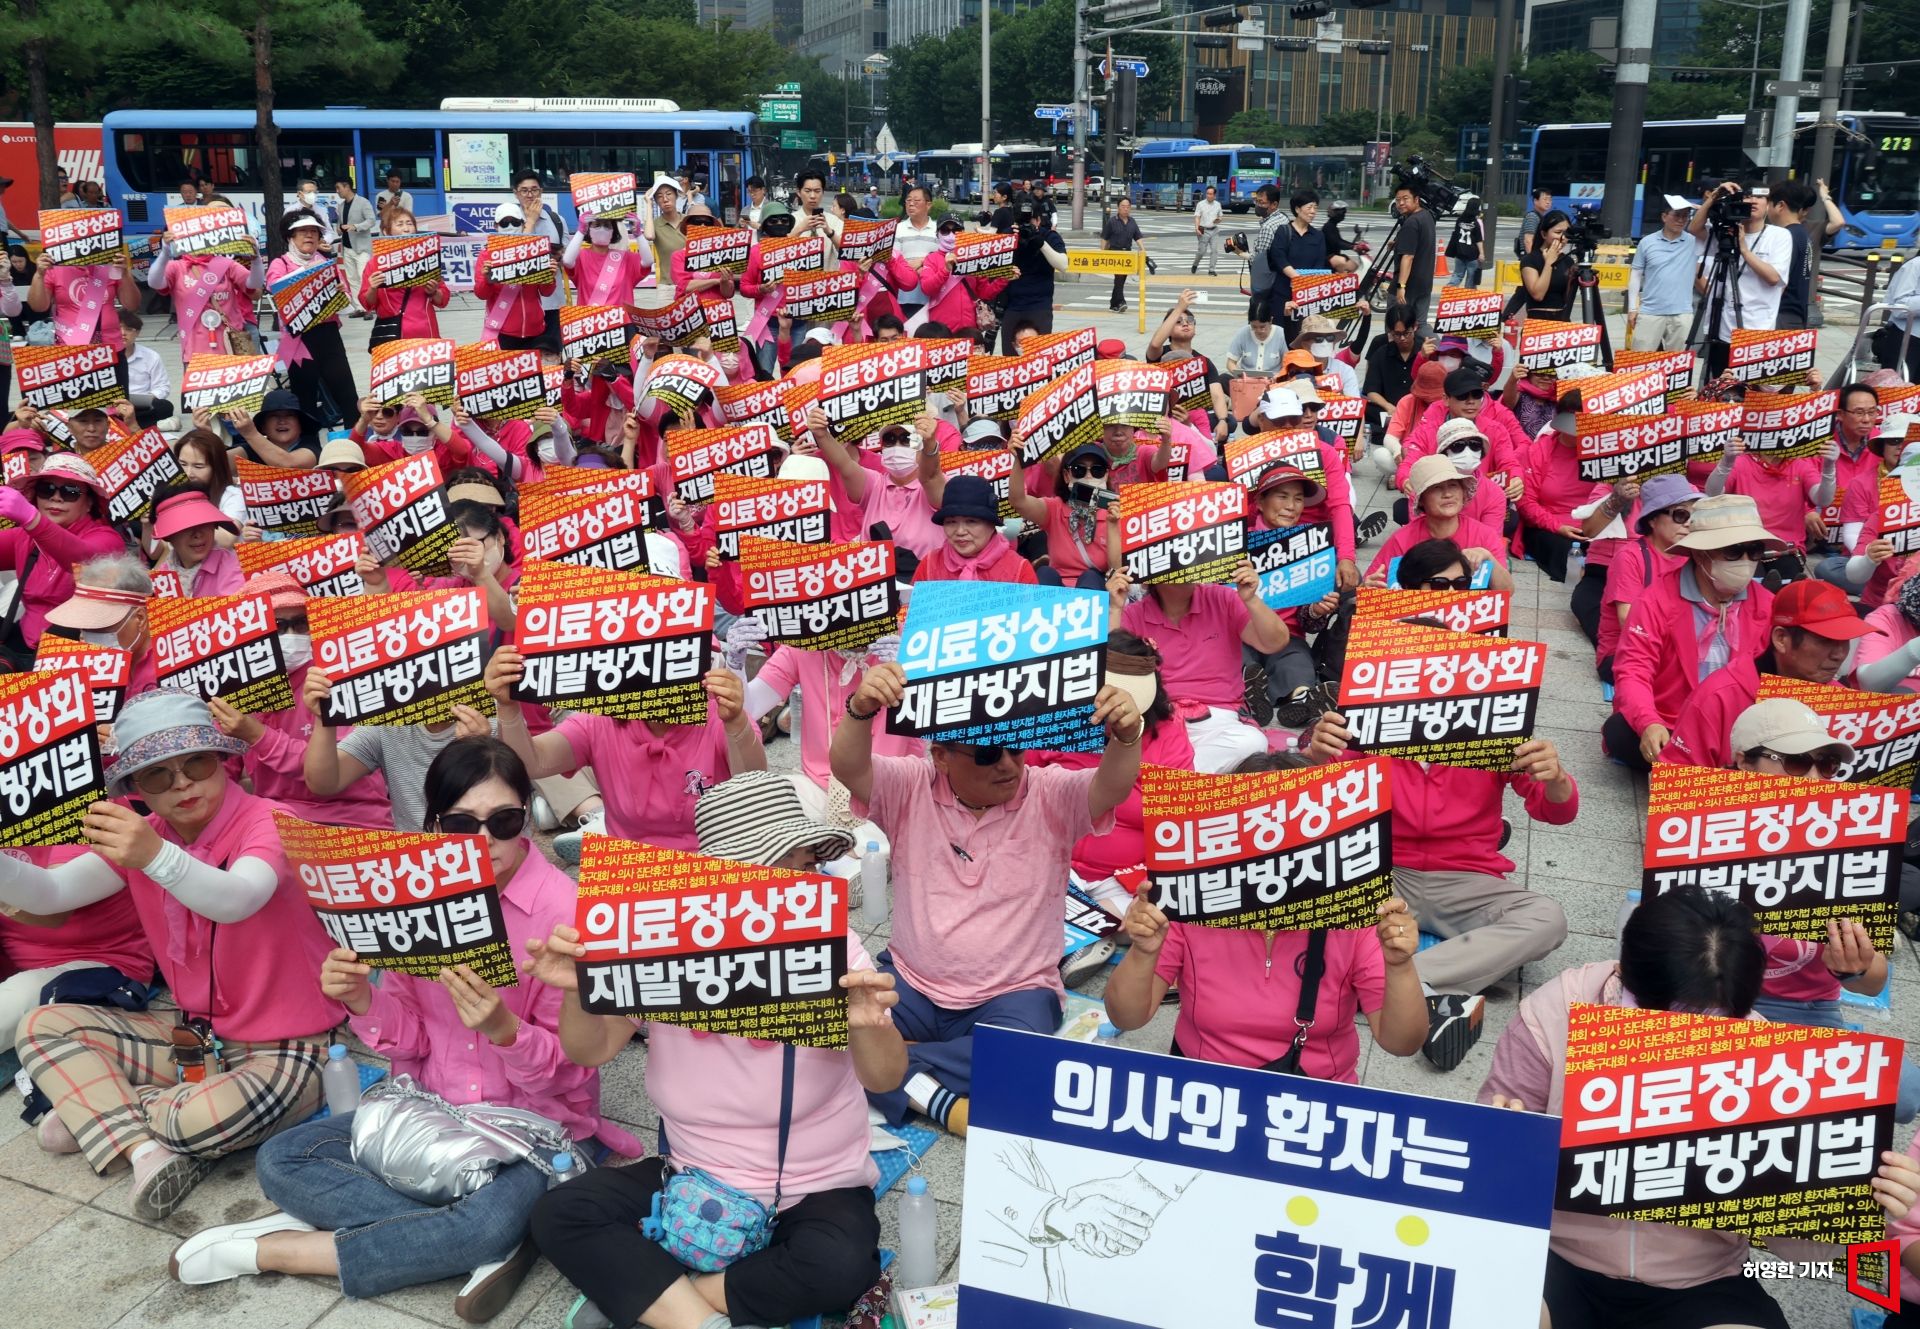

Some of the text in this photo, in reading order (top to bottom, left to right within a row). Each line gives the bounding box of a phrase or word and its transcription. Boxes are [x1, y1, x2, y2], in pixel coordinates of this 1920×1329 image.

[1881, 137, 1912, 151] 273
[574, 175, 635, 203] 의료정상화
[44, 209, 121, 244] 의료정상화
[171, 209, 245, 239] 의료정상화
[689, 231, 749, 254] 의료정상화
[842, 220, 898, 246] 의료정상화
[46, 231, 120, 265] 재발방지법
[377, 236, 439, 269] 의료정상화
[490, 237, 550, 266] 의료정상화
[687, 247, 749, 271] 재발방지법
[763, 238, 823, 265] 의료정상화
[841, 233, 894, 260] 재발방지법
[955, 252, 1016, 276] 재발방지법
[957, 235, 1018, 260] 의료정상화
[1092, 256, 1132, 269] 넘지마시오
[283, 266, 337, 320] 의료정상화
[786, 272, 857, 301] 의료정상화
[786, 291, 857, 318] 재발방지법
[1296, 276, 1358, 304] 의료정상화
[1297, 292, 1357, 317] 재발방지법
[1439, 293, 1502, 316] 의료정상화
[288, 281, 340, 337] 재발방지법
[562, 308, 627, 343] 의료정상화
[1436, 311, 1500, 334] 재발방지법
[1523, 344, 1596, 371] 재발방지법
[1524, 326, 1599, 352] 의료정상화
[1733, 330, 1814, 364] 의료정상화
[22, 346, 115, 387] 의료정상화
[187, 356, 276, 391] 의료정상화
[371, 341, 452, 382] 의료정상화
[372, 362, 451, 402] 재발방지법
[460, 352, 539, 392] 의료정상화
[823, 343, 923, 394] 의료정상화
[970, 356, 1050, 393] 의료정상화
[1733, 351, 1812, 382] 재발방지법
[26, 366, 118, 409] 재발방지법
[184, 374, 268, 409] 재발방지법
[462, 375, 543, 416] 재발방지법
[822, 374, 921, 422] 재발방지법
[1019, 366, 1094, 435] 의료정상화
[1587, 371, 1667, 415] 의료정상화
[1021, 392, 1097, 462] 재발방지법
[1744, 392, 1838, 430] 의료정상화
[675, 426, 769, 476] 의료정상화
[1231, 432, 1317, 474] 의료정상화
[1580, 415, 1683, 457] 의료정상화
[1744, 415, 1833, 450] 재발방지법
[1581, 438, 1683, 480] 재발방지법
[109, 451, 179, 522] 재발방지법
[243, 470, 332, 503] 의료정상화
[719, 480, 825, 528] 의료정상화
[524, 498, 635, 559] 의료정상화
[1126, 486, 1244, 546] 의료정상화
[1126, 520, 1244, 579] 재발방지법
[750, 544, 889, 601] 의료정상화
[524, 587, 708, 647] 의료정상화
[752, 582, 888, 637] 재발방지법
[156, 597, 268, 669] 의료정상화
[322, 592, 481, 675] 의료정상화
[903, 595, 1104, 672] 의료정상화
[328, 637, 482, 721] 재발방지법
[518, 637, 701, 698] 재발방지법
[1349, 646, 1539, 699] 의료정상화
[895, 651, 1099, 729] 재발방지법
[0, 672, 86, 758] 정상화
[1346, 693, 1529, 746] 재발방지법
[1, 733, 95, 817] 방지법
[1155, 763, 1383, 864] 의료정상화
[1656, 793, 1900, 860] 의료정상화
[300, 839, 482, 905] 의료정상화
[1156, 822, 1380, 917] 재발방지법
[316, 894, 493, 953] 재발방지법
[584, 881, 838, 955] 의료정상화
[587, 945, 832, 1008] 재발방지법
[1619, 1037, 1642, 1051] 의사
[1643, 1030, 1688, 1047] 집단휴진
[1689, 1026, 1712, 1041] 철회
[1714, 1026, 1725, 1038] 및
[1729, 1022, 1751, 1036] 재발
[1638, 1050, 1661, 1064] 의사
[1663, 1043, 1708, 1062] 집단휴진
[1710, 1039, 1732, 1055] 철회
[1734, 1038, 1746, 1051] 및
[1749, 1034, 1772, 1050] 재발
[1774, 1028, 1810, 1046] 방지법
[1576, 1041, 1889, 1134] 의료정상화
[1052, 1060, 1470, 1193] 의사와 환자는
[1570, 1115, 1876, 1205] 재발방지법
[1678, 1202, 1702, 1218] 철회
[1704, 1203, 1715, 1215] 및
[1717, 1198, 1740, 1213] 재발
[1743, 1194, 1777, 1211] 방지법
[1778, 1192, 1802, 1207] 제정
[1804, 1184, 1872, 1203] 환자촉구대회
[1831, 1215, 1854, 1230] 의사
